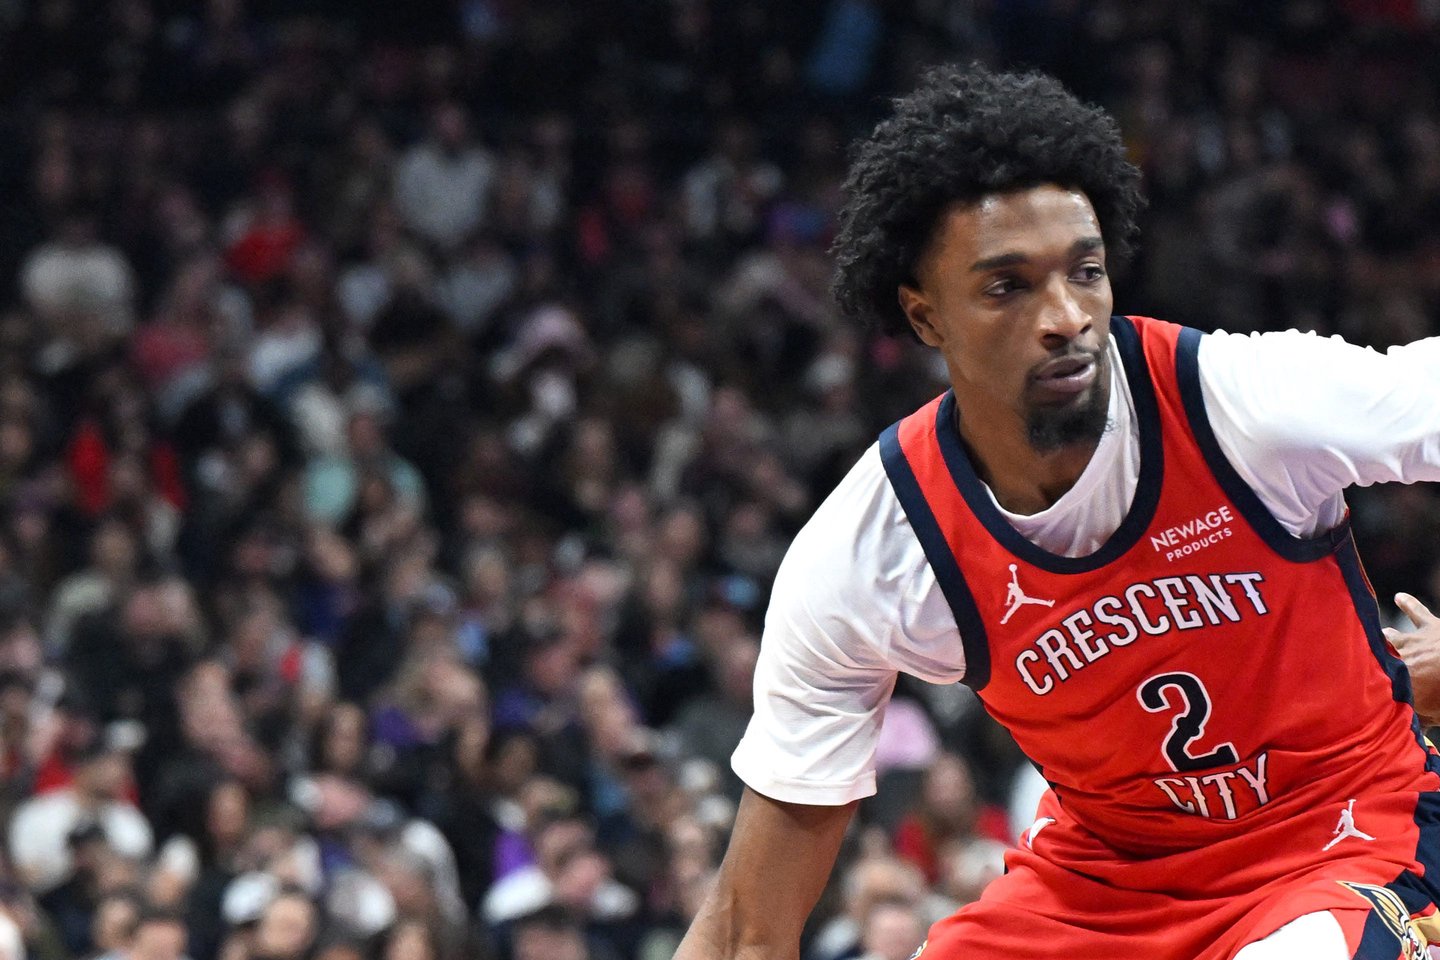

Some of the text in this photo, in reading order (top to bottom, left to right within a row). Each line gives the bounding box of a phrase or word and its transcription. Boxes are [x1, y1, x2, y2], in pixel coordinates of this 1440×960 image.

[1150, 506, 1234, 552] NEWAGE
[1166, 527, 1233, 562] PRODUCTS
[1015, 572, 1270, 695] CRESCENT
[1136, 671, 1238, 774] 2
[1156, 753, 1271, 820] CITY
